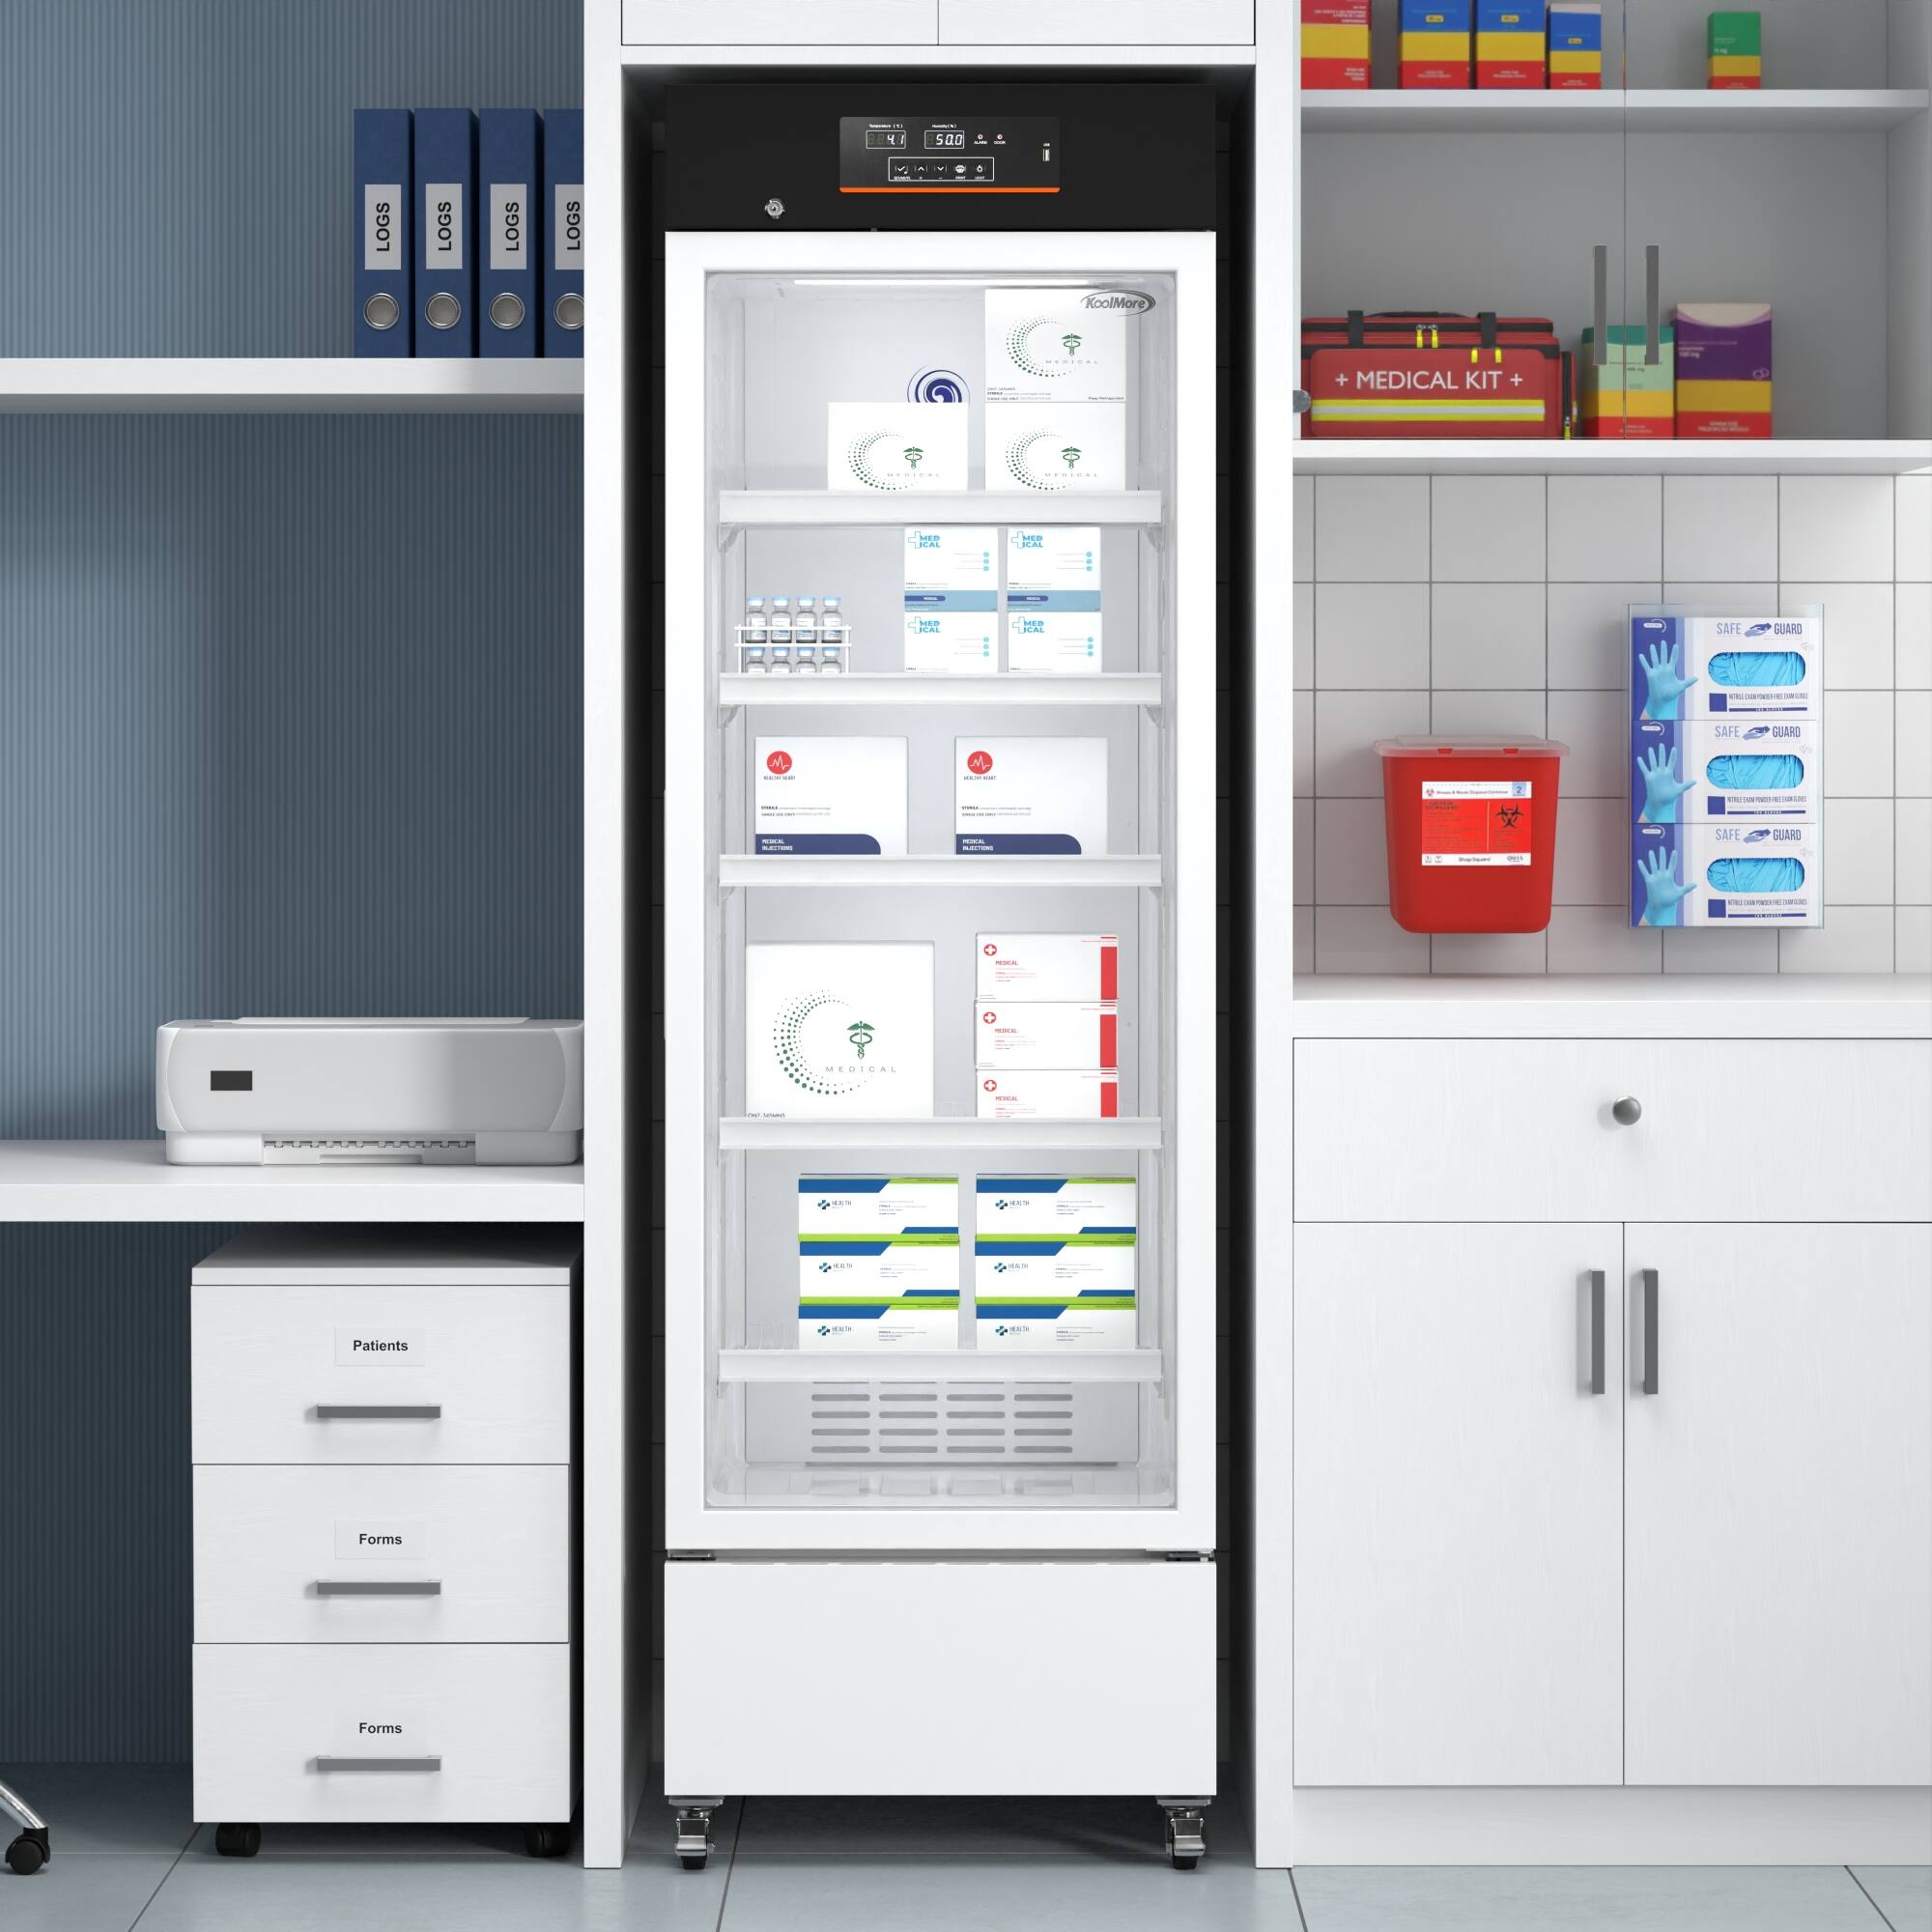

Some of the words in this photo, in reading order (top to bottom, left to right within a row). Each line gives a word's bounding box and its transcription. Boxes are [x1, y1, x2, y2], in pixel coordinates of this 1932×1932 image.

[888, 134, 904, 145] 4.1
[936, 133, 963, 146] 50.0
[376, 202, 390, 251] LOGS
[438, 201, 452, 251] LOGS
[505, 202, 520, 251] LOGS
[566, 201, 581, 251] LOGS
[1085, 296, 1146, 310] KoolMore
[1356, 370, 1459, 389] MEDICAL
[1466, 370, 1502, 389] KIT
[1717, 623, 1742, 635] SAFE
[1774, 623, 1803, 635] GUARD
[1715, 725, 1740, 738] SAFE
[1772, 725, 1801, 738] GUARD
[1716, 829, 1741, 840] SAFE
[1773, 829, 1802, 841] GUARD
[353, 1340, 409, 1351] Patients
[358, 1533, 403, 1545] Forms
[358, 1722, 403, 1734] Forms
